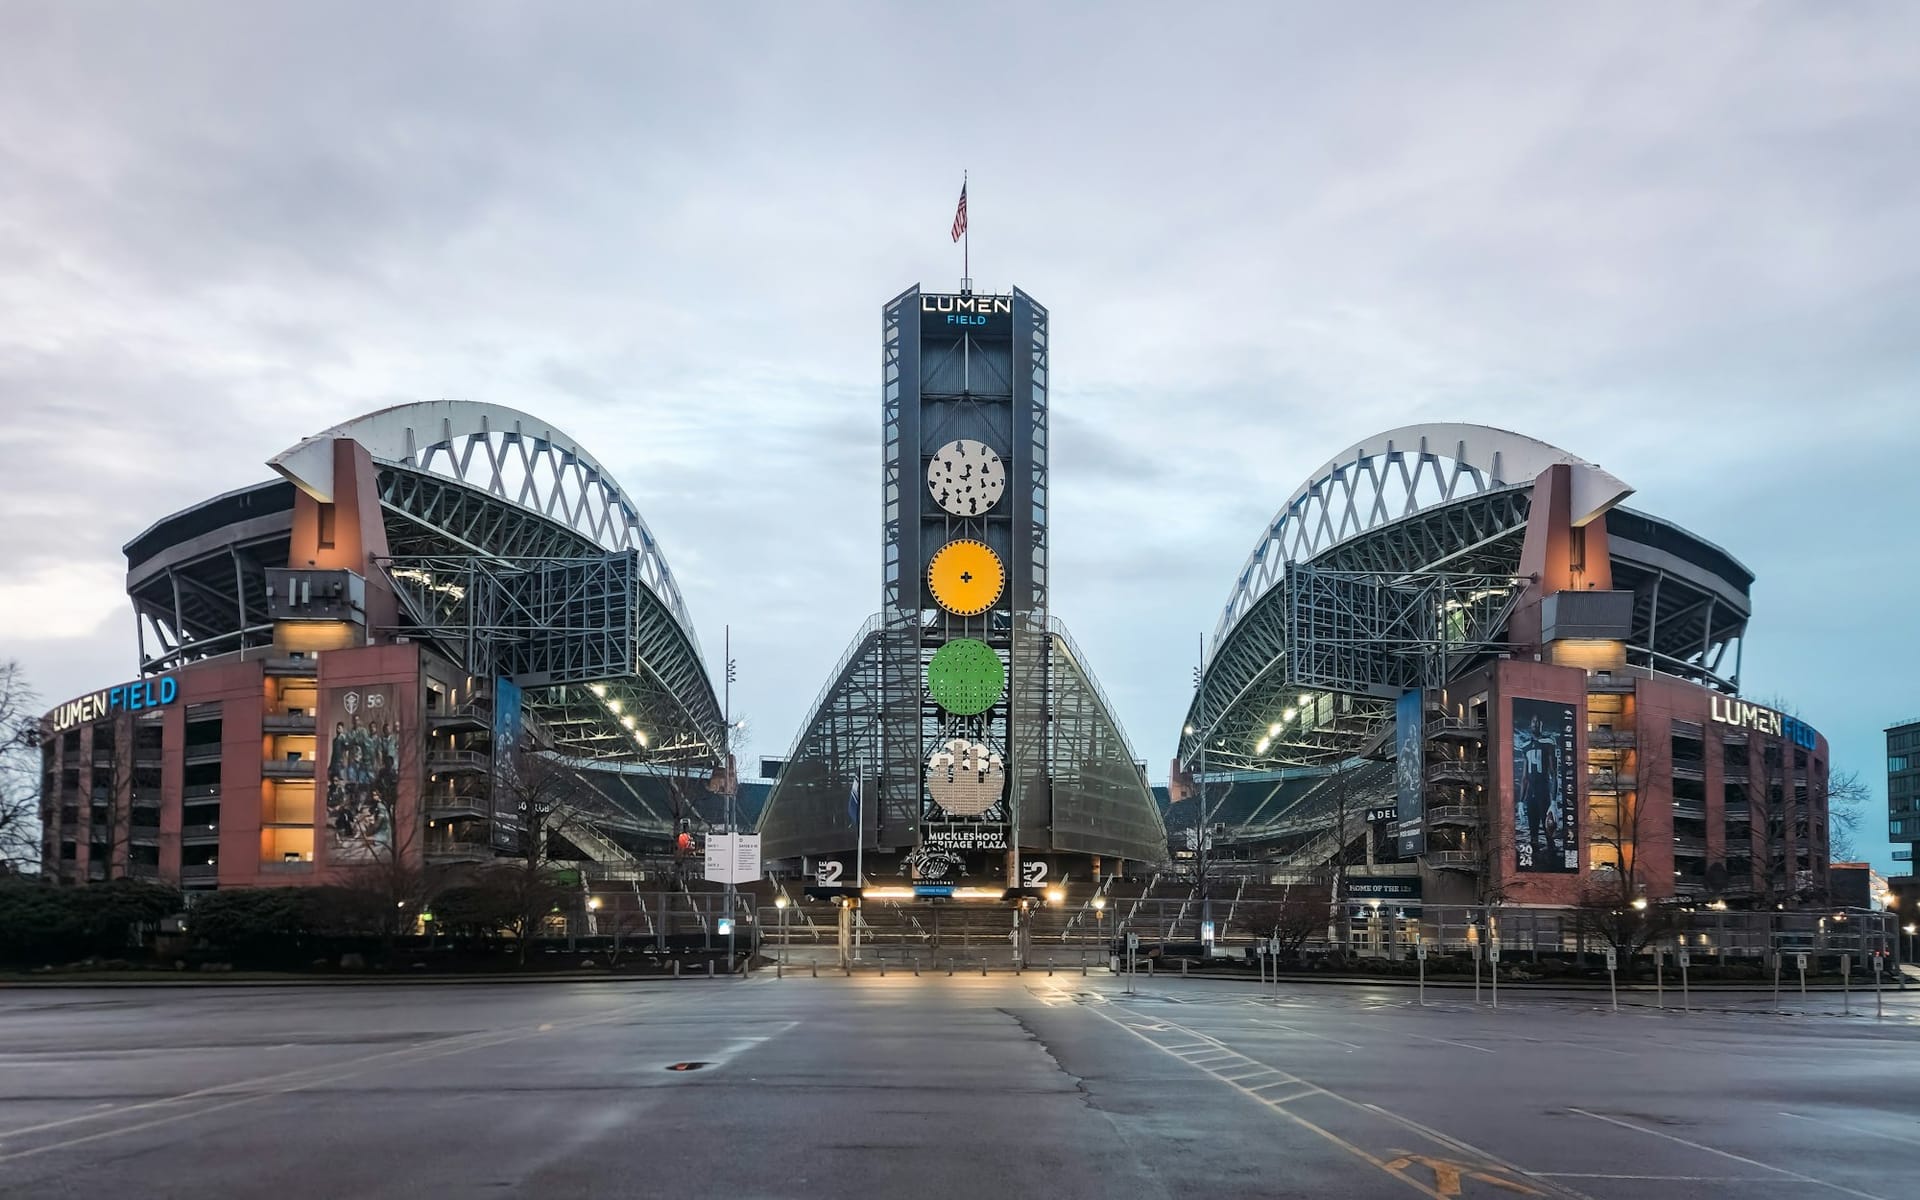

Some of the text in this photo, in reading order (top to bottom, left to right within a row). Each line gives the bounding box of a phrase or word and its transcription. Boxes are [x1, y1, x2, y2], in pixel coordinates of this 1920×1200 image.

[922, 297, 1011, 313] LUMEN
[947, 315, 986, 325] FIELD
[53, 676, 177, 732] LUMEN FIELD
[1710, 695, 1817, 749] LUMEN FIELD
[928, 832, 1004, 841] MUCKLESHOOT
[977, 840, 1008, 849] PLAZA
[1519, 855, 1533, 867] 24
[818, 861, 843, 887] GATE 2
[1023, 861, 1048, 888] GATE 2
